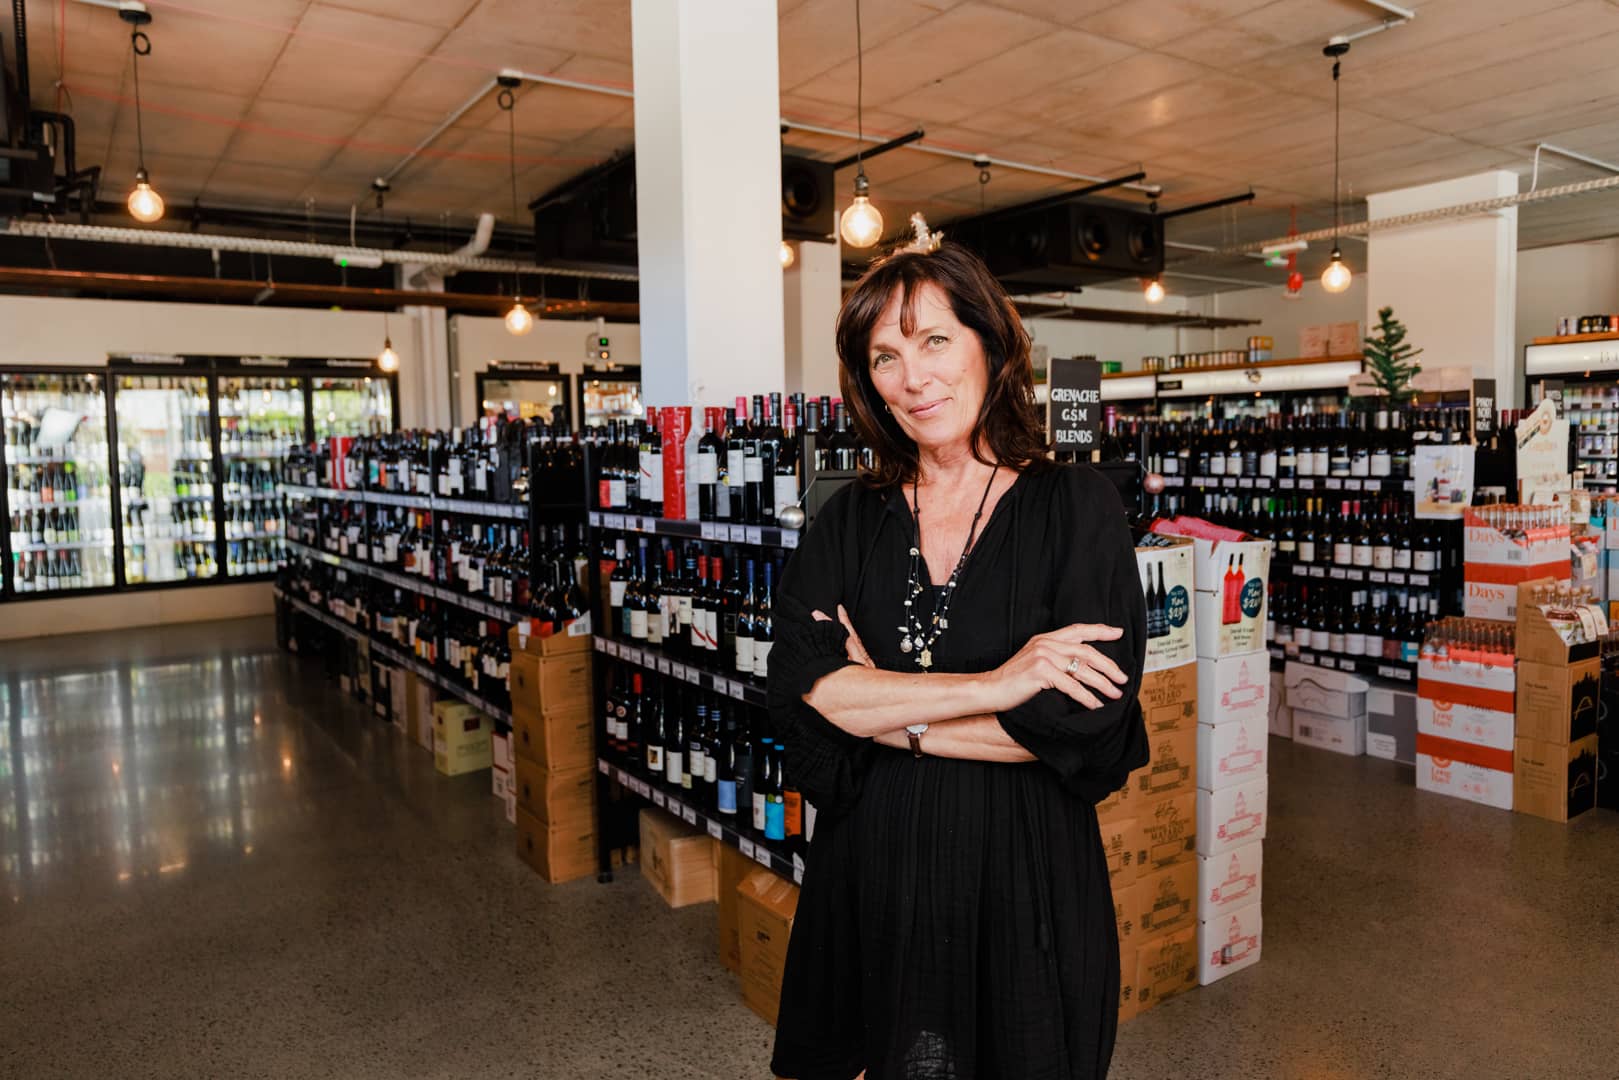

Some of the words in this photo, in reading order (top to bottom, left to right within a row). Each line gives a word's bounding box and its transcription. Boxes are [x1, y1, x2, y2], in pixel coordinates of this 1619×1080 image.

[1051, 388, 1099, 403] GRENACHE
[1056, 430, 1092, 443] BLENDS
[1469, 583, 1504, 600] Days
